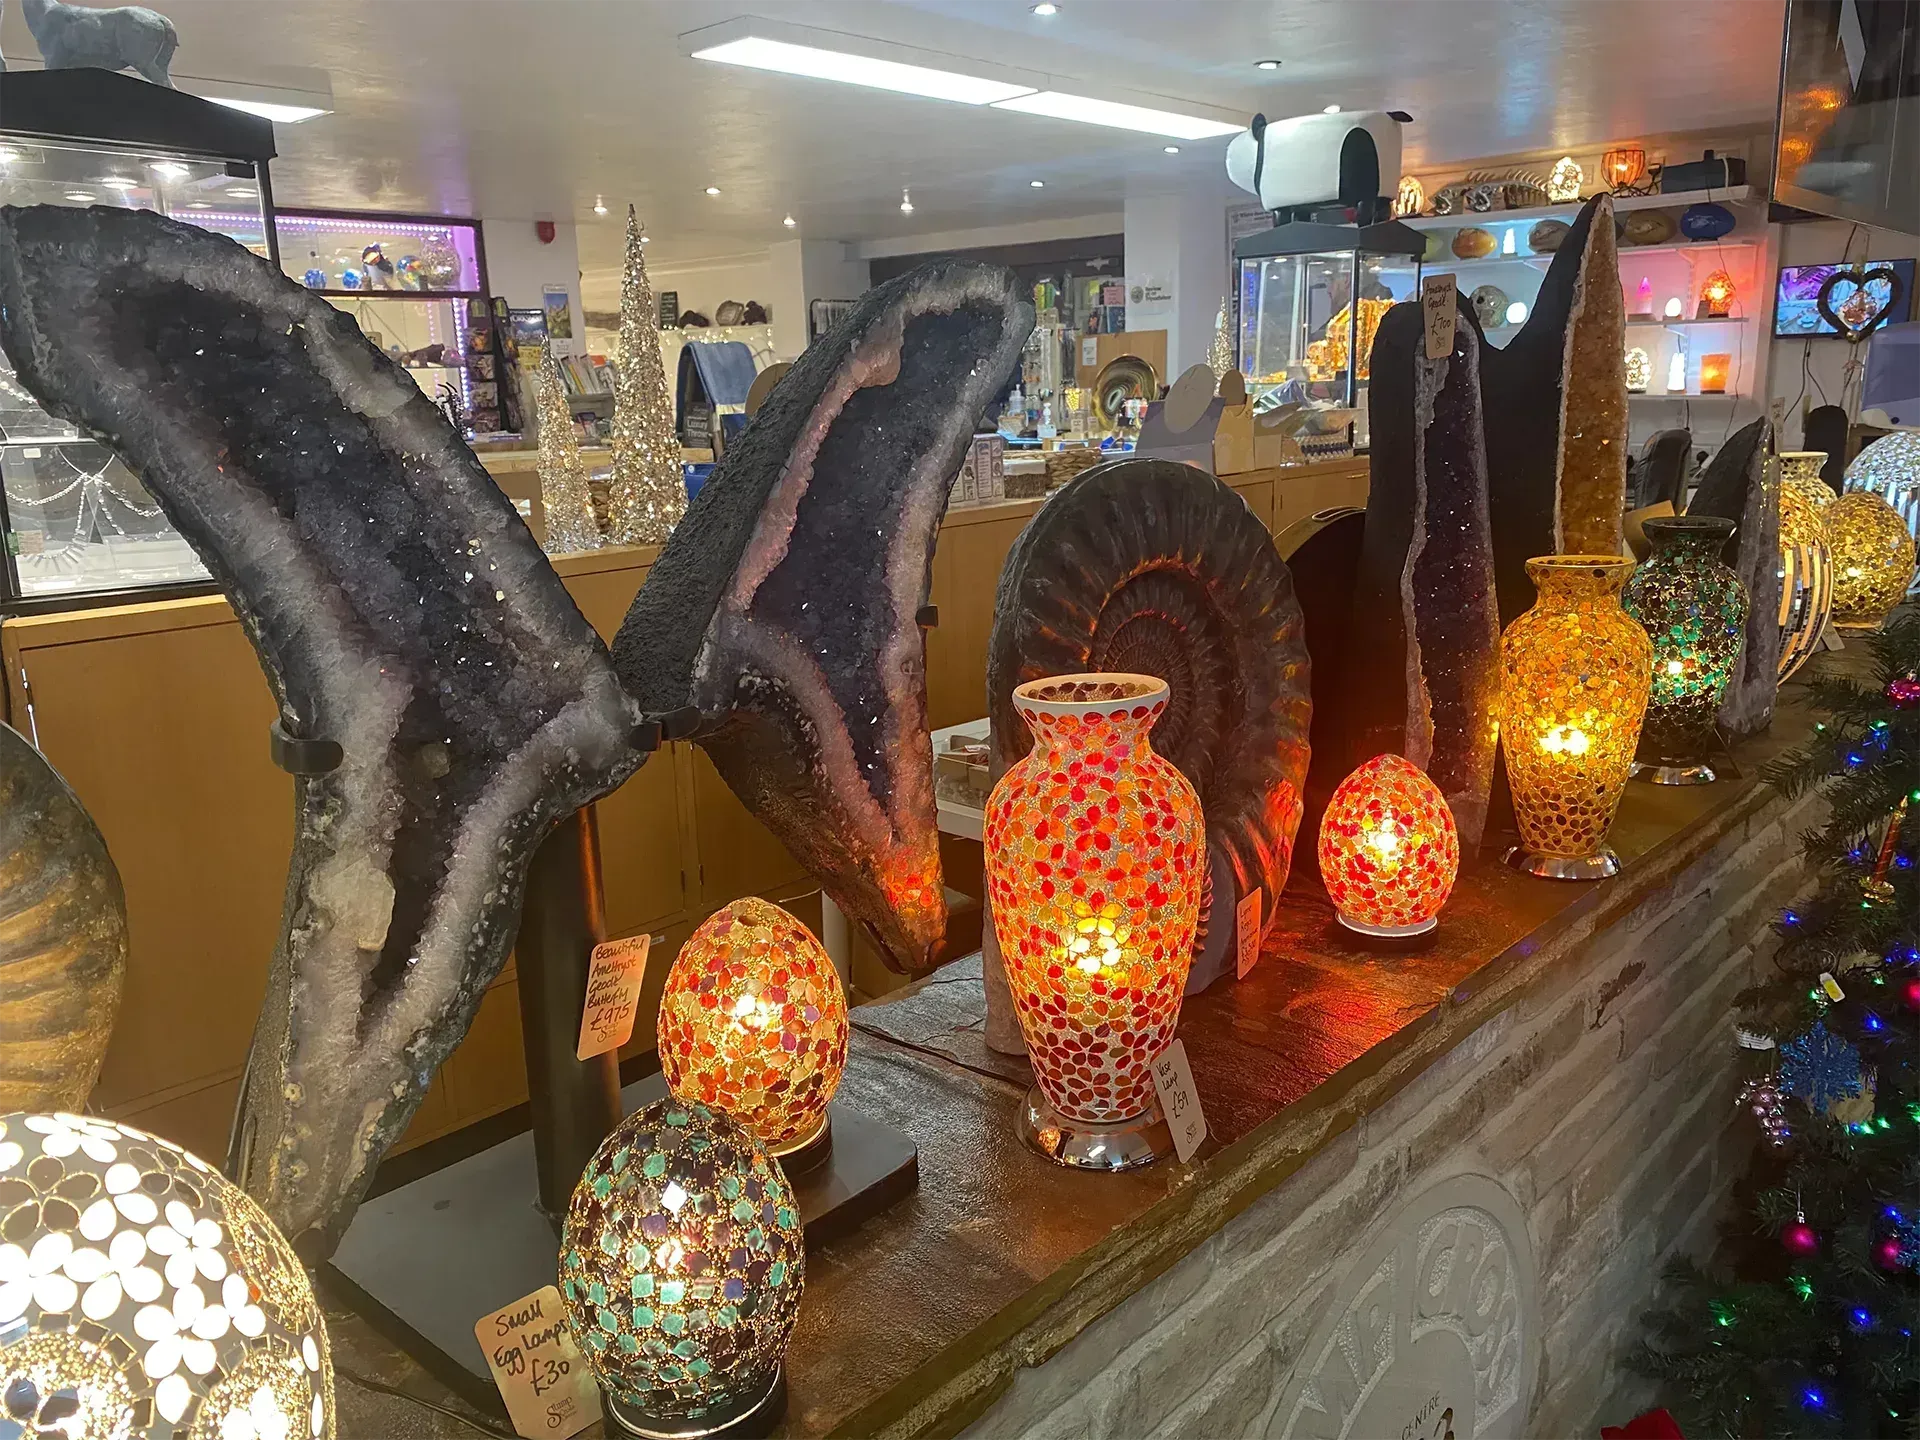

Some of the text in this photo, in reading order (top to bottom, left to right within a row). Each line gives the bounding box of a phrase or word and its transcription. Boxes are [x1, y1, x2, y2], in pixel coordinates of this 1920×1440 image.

[1430, 312, 1452, 336] £700
[595, 938, 645, 960] Beautiful
[588, 976, 619, 994] Geode
[590, 1001, 632, 1031] £975
[1171, 1090, 1189, 1119] £59
[495, 1299, 544, 1337] Small
[493, 1319, 569, 1377] Egg Lamps
[529, 1358, 570, 1397] £30
